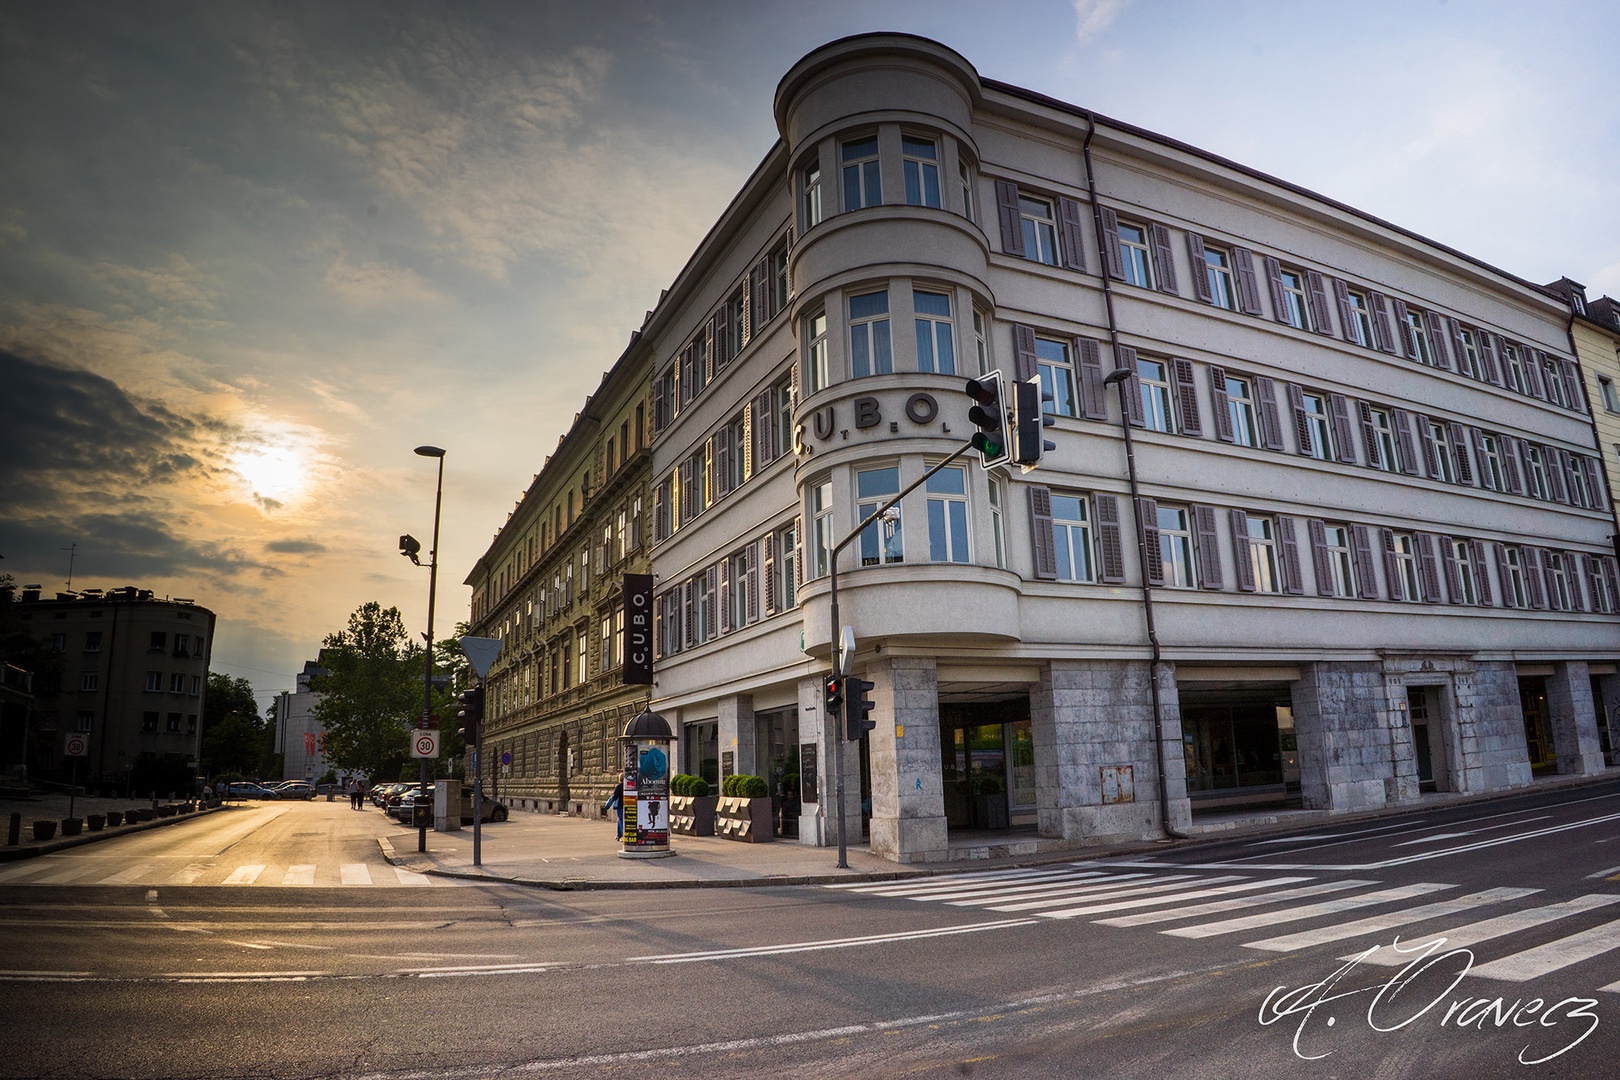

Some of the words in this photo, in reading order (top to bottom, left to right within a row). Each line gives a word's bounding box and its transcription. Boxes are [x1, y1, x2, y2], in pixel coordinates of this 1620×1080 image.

[793, 392, 939, 456] CUBO
[633, 594, 645, 664] CUBO
[71, 743, 81, 751] 30
[420, 741, 431, 751] 30
